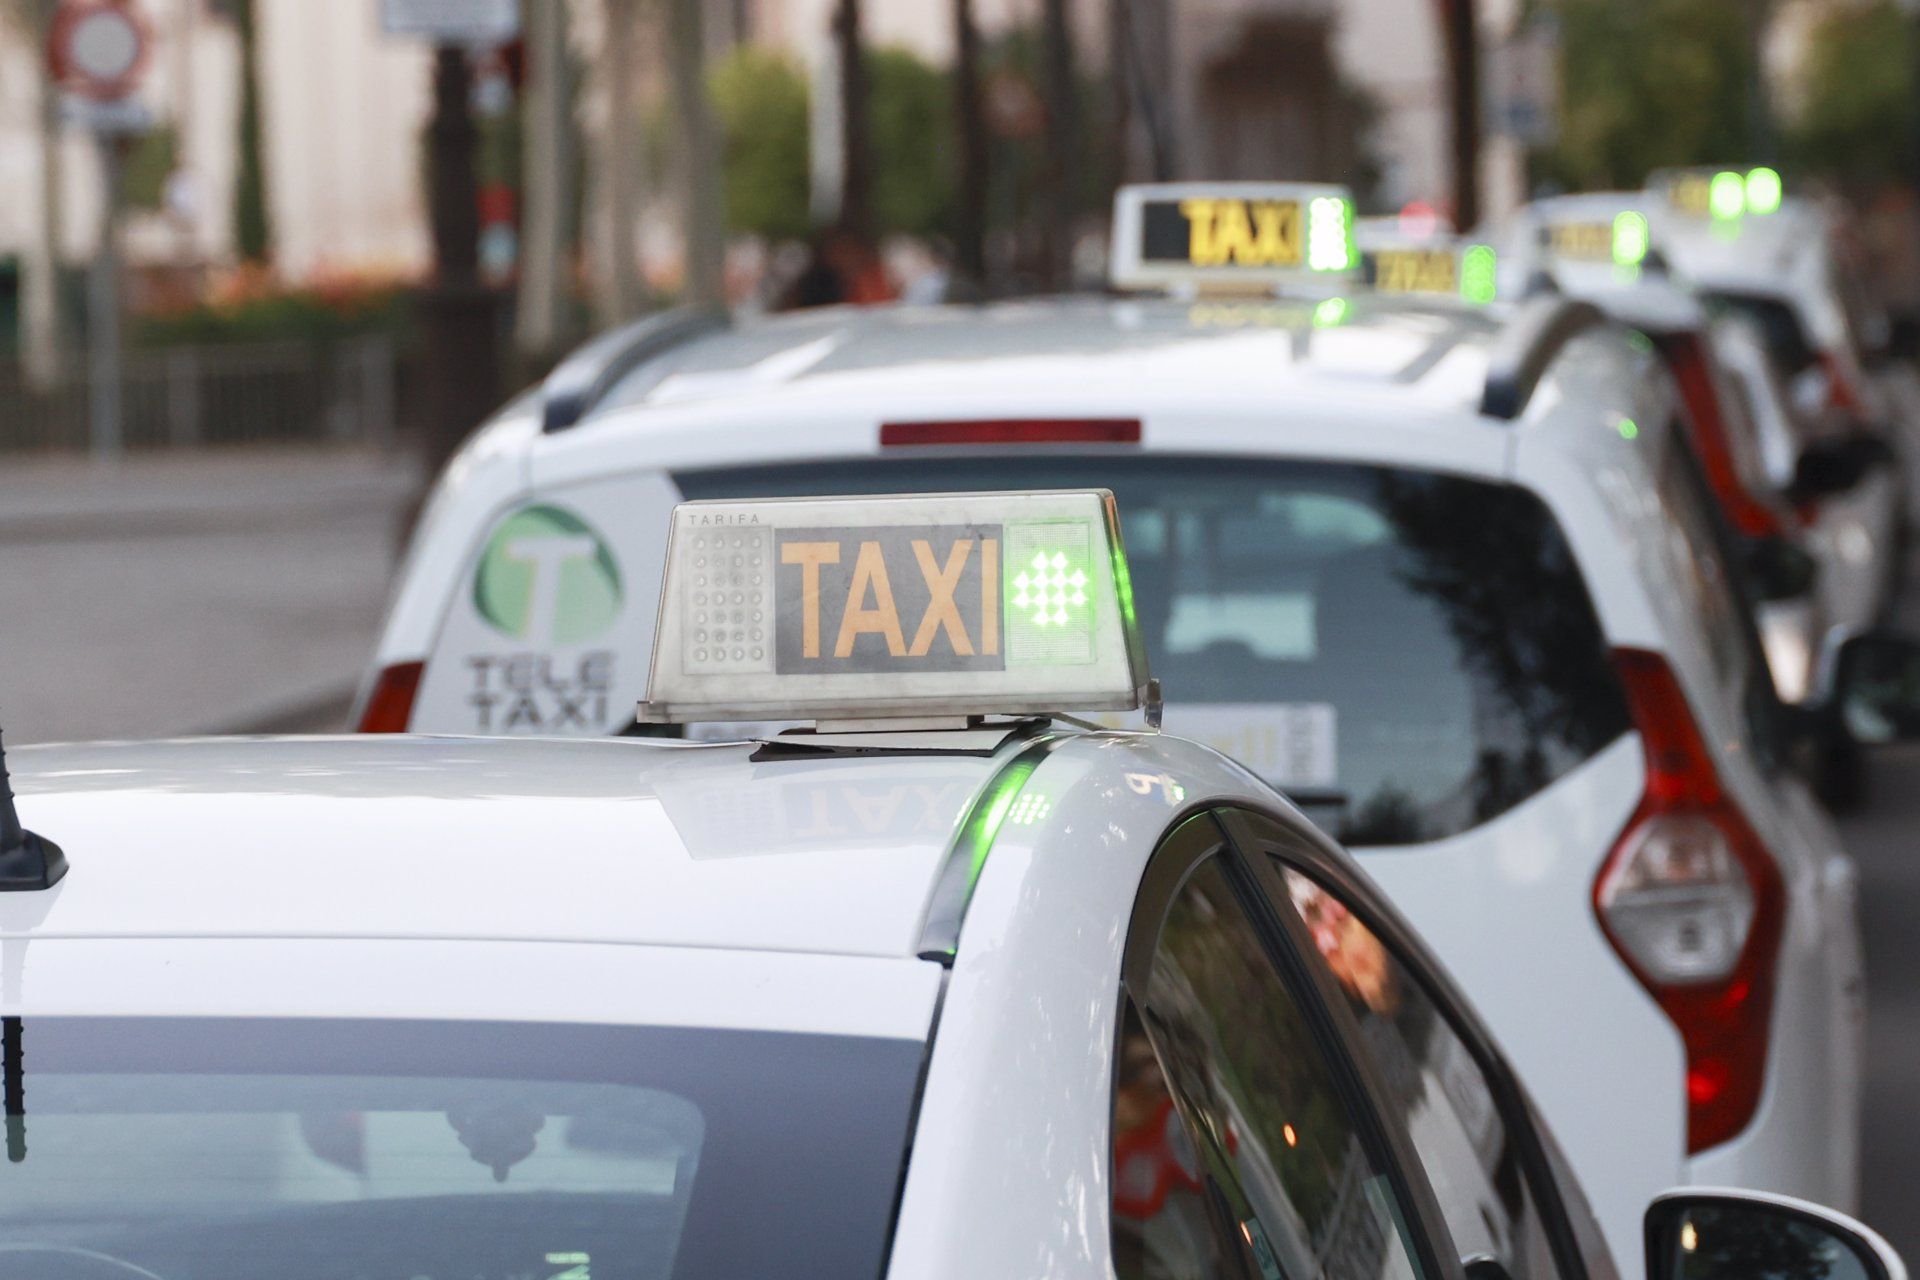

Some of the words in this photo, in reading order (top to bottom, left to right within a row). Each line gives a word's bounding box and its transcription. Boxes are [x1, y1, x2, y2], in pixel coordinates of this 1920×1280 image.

[1178, 197, 1299, 267] TAXI
[689, 513, 759, 525] TARIFA
[781, 538, 998, 659] TAXI
[465, 652, 614, 691] TELE
[466, 694, 608, 730] TAXI
